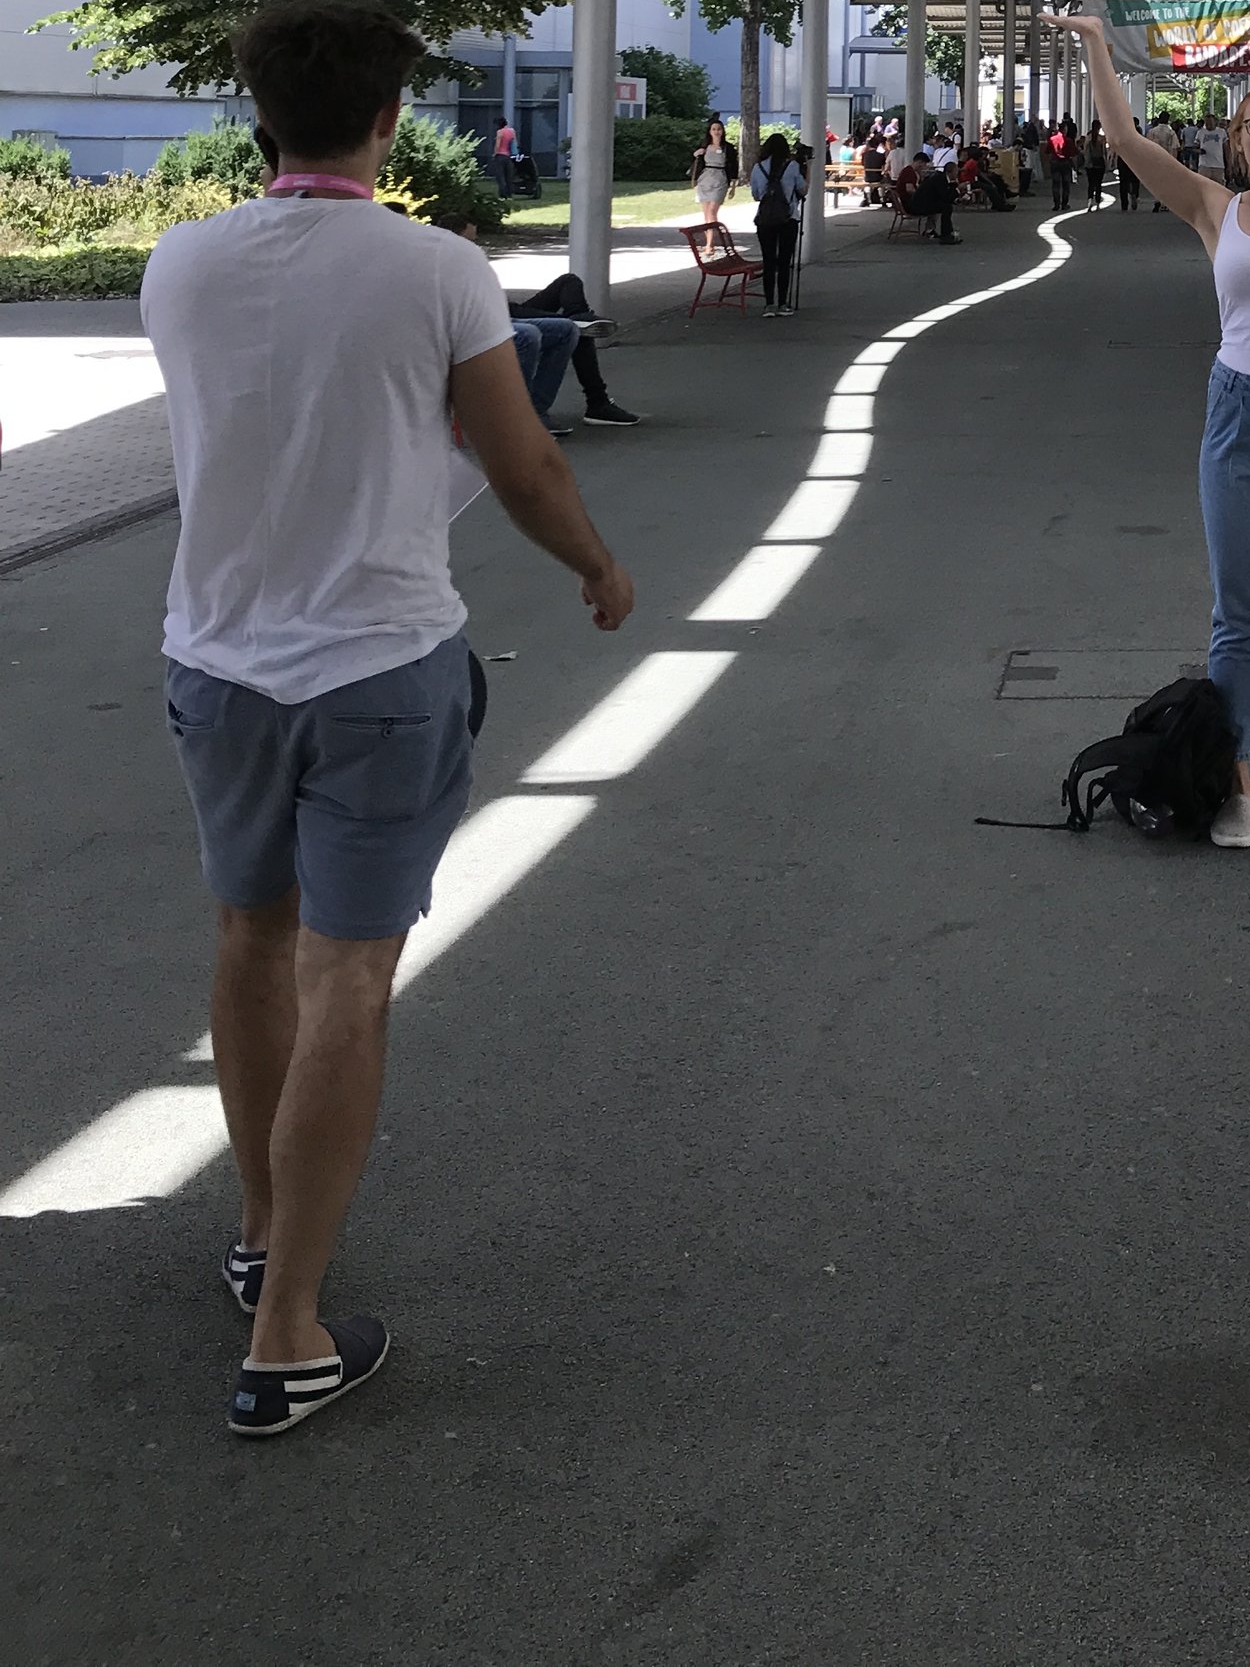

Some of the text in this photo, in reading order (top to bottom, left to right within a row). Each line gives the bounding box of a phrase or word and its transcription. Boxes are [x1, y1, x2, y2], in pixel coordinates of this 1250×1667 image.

[1125, 6, 1190, 21] WELCOME TO THE
[1154, 24, 1198, 46] WORLD
[1203, 21, 1218, 41] OF
